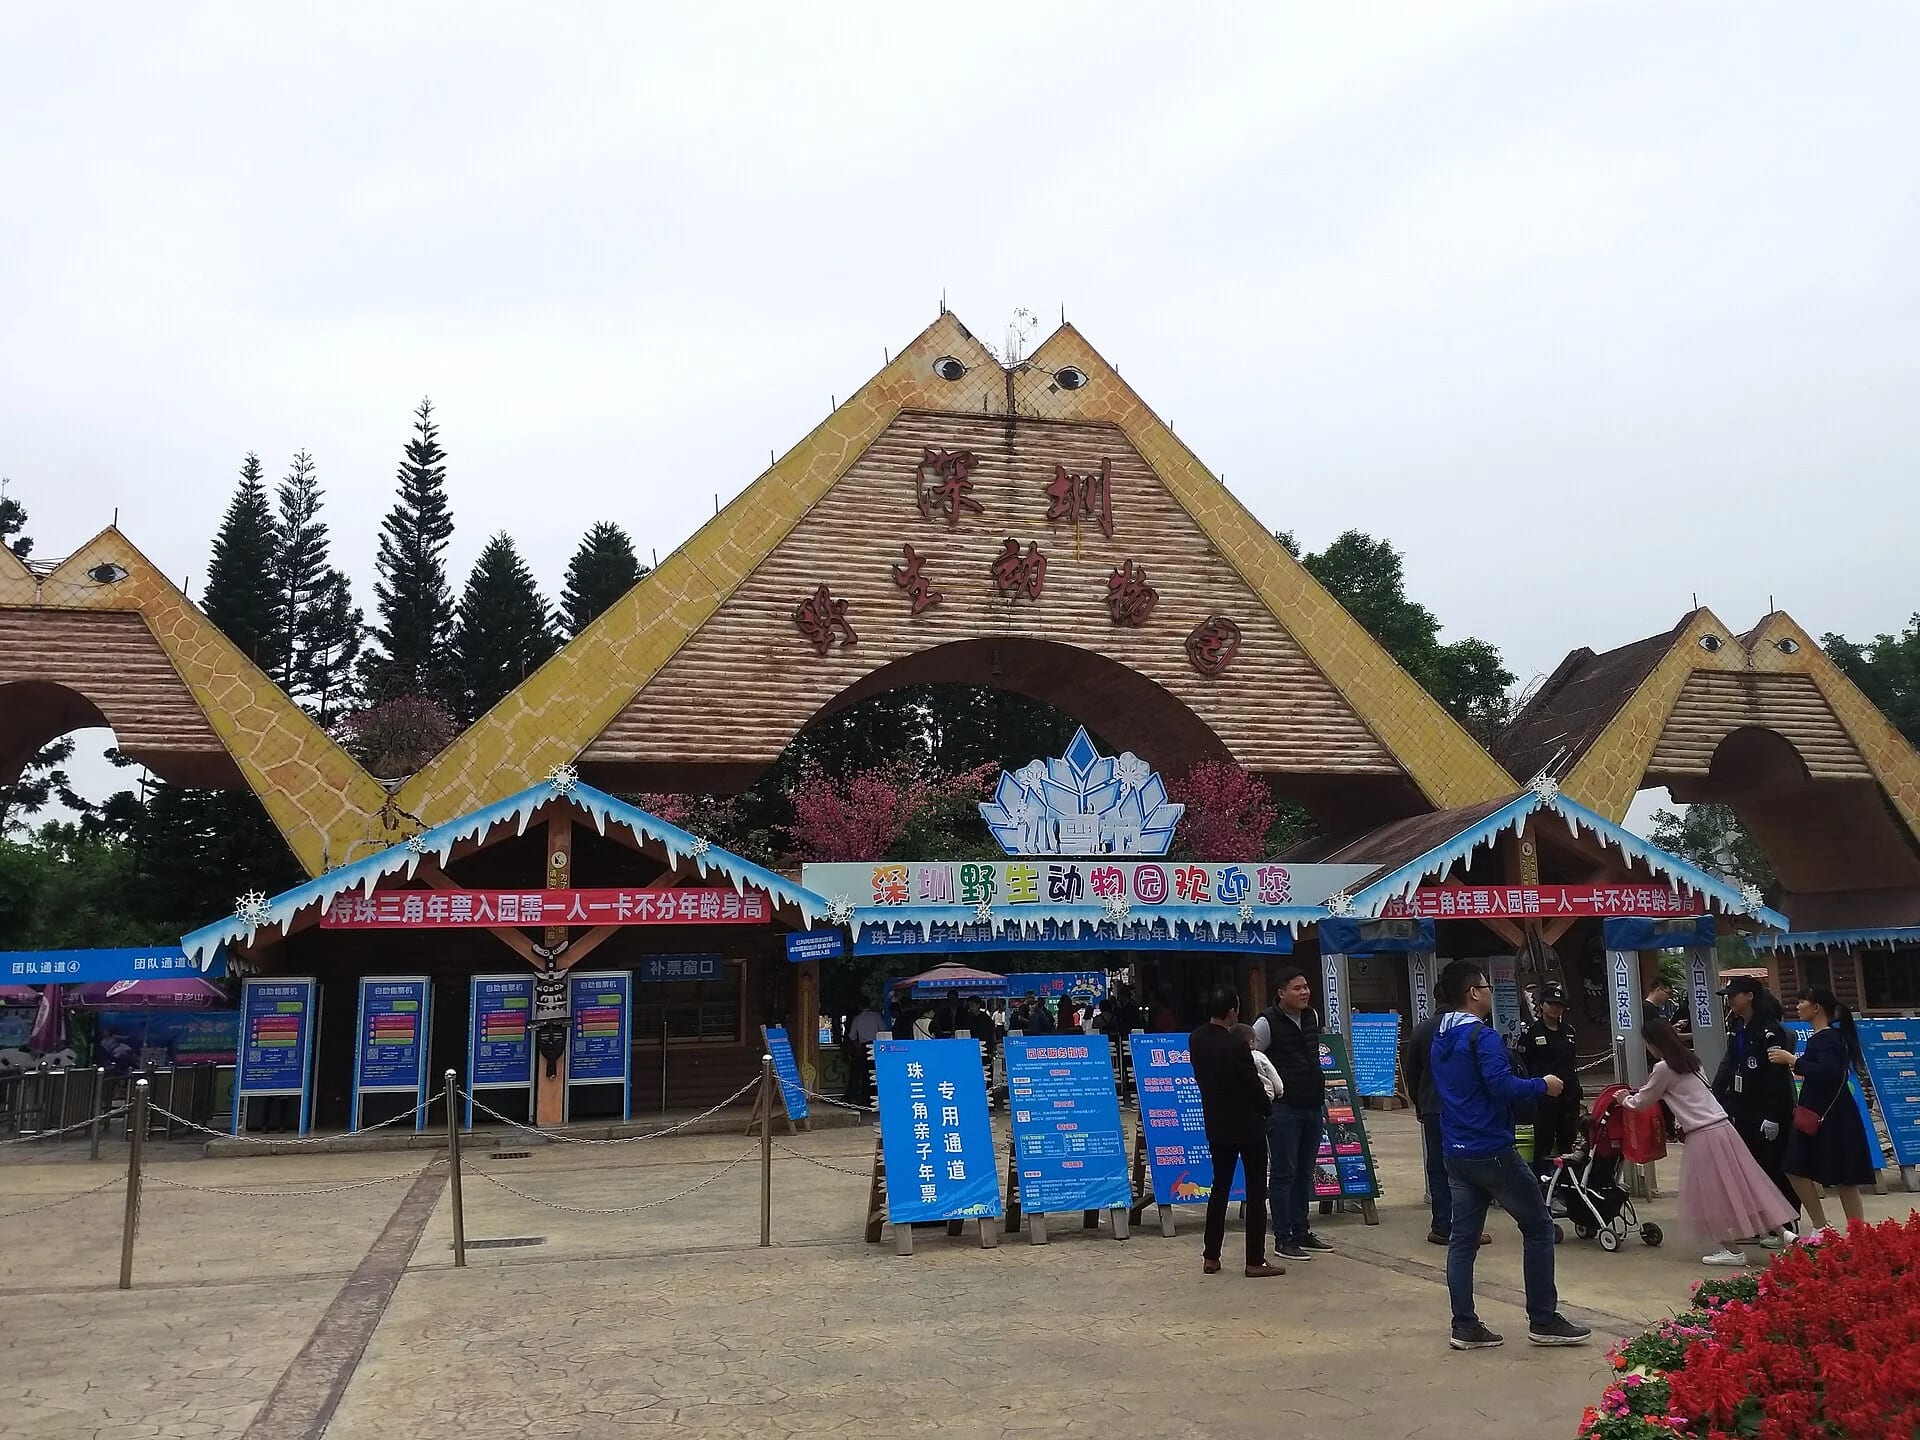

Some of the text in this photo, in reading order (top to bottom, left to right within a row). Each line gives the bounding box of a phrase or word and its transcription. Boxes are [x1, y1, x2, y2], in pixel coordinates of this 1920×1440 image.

[916, 446, 1113, 539] 深圳
[792, 538, 1242, 675] 野生动物园
[329, 892, 764, 923] 持珠三角年票入园需一人一卡不分年龄身高
[871, 864, 1293, 905] 深圳野生动物园欢迎您
[1387, 888, 1695, 917] 持珠三角年票入园需一人一卡不分年龄身高
[649, 959, 714, 976] 补票窗口
[1614, 951, 1633, 1030] 入口安检
[1692, 951, 1712, 1028] 入口安检
[906, 1061, 938, 1204] 珠三角亲子年票
[937, 1080, 967, 1181] 专用通道
